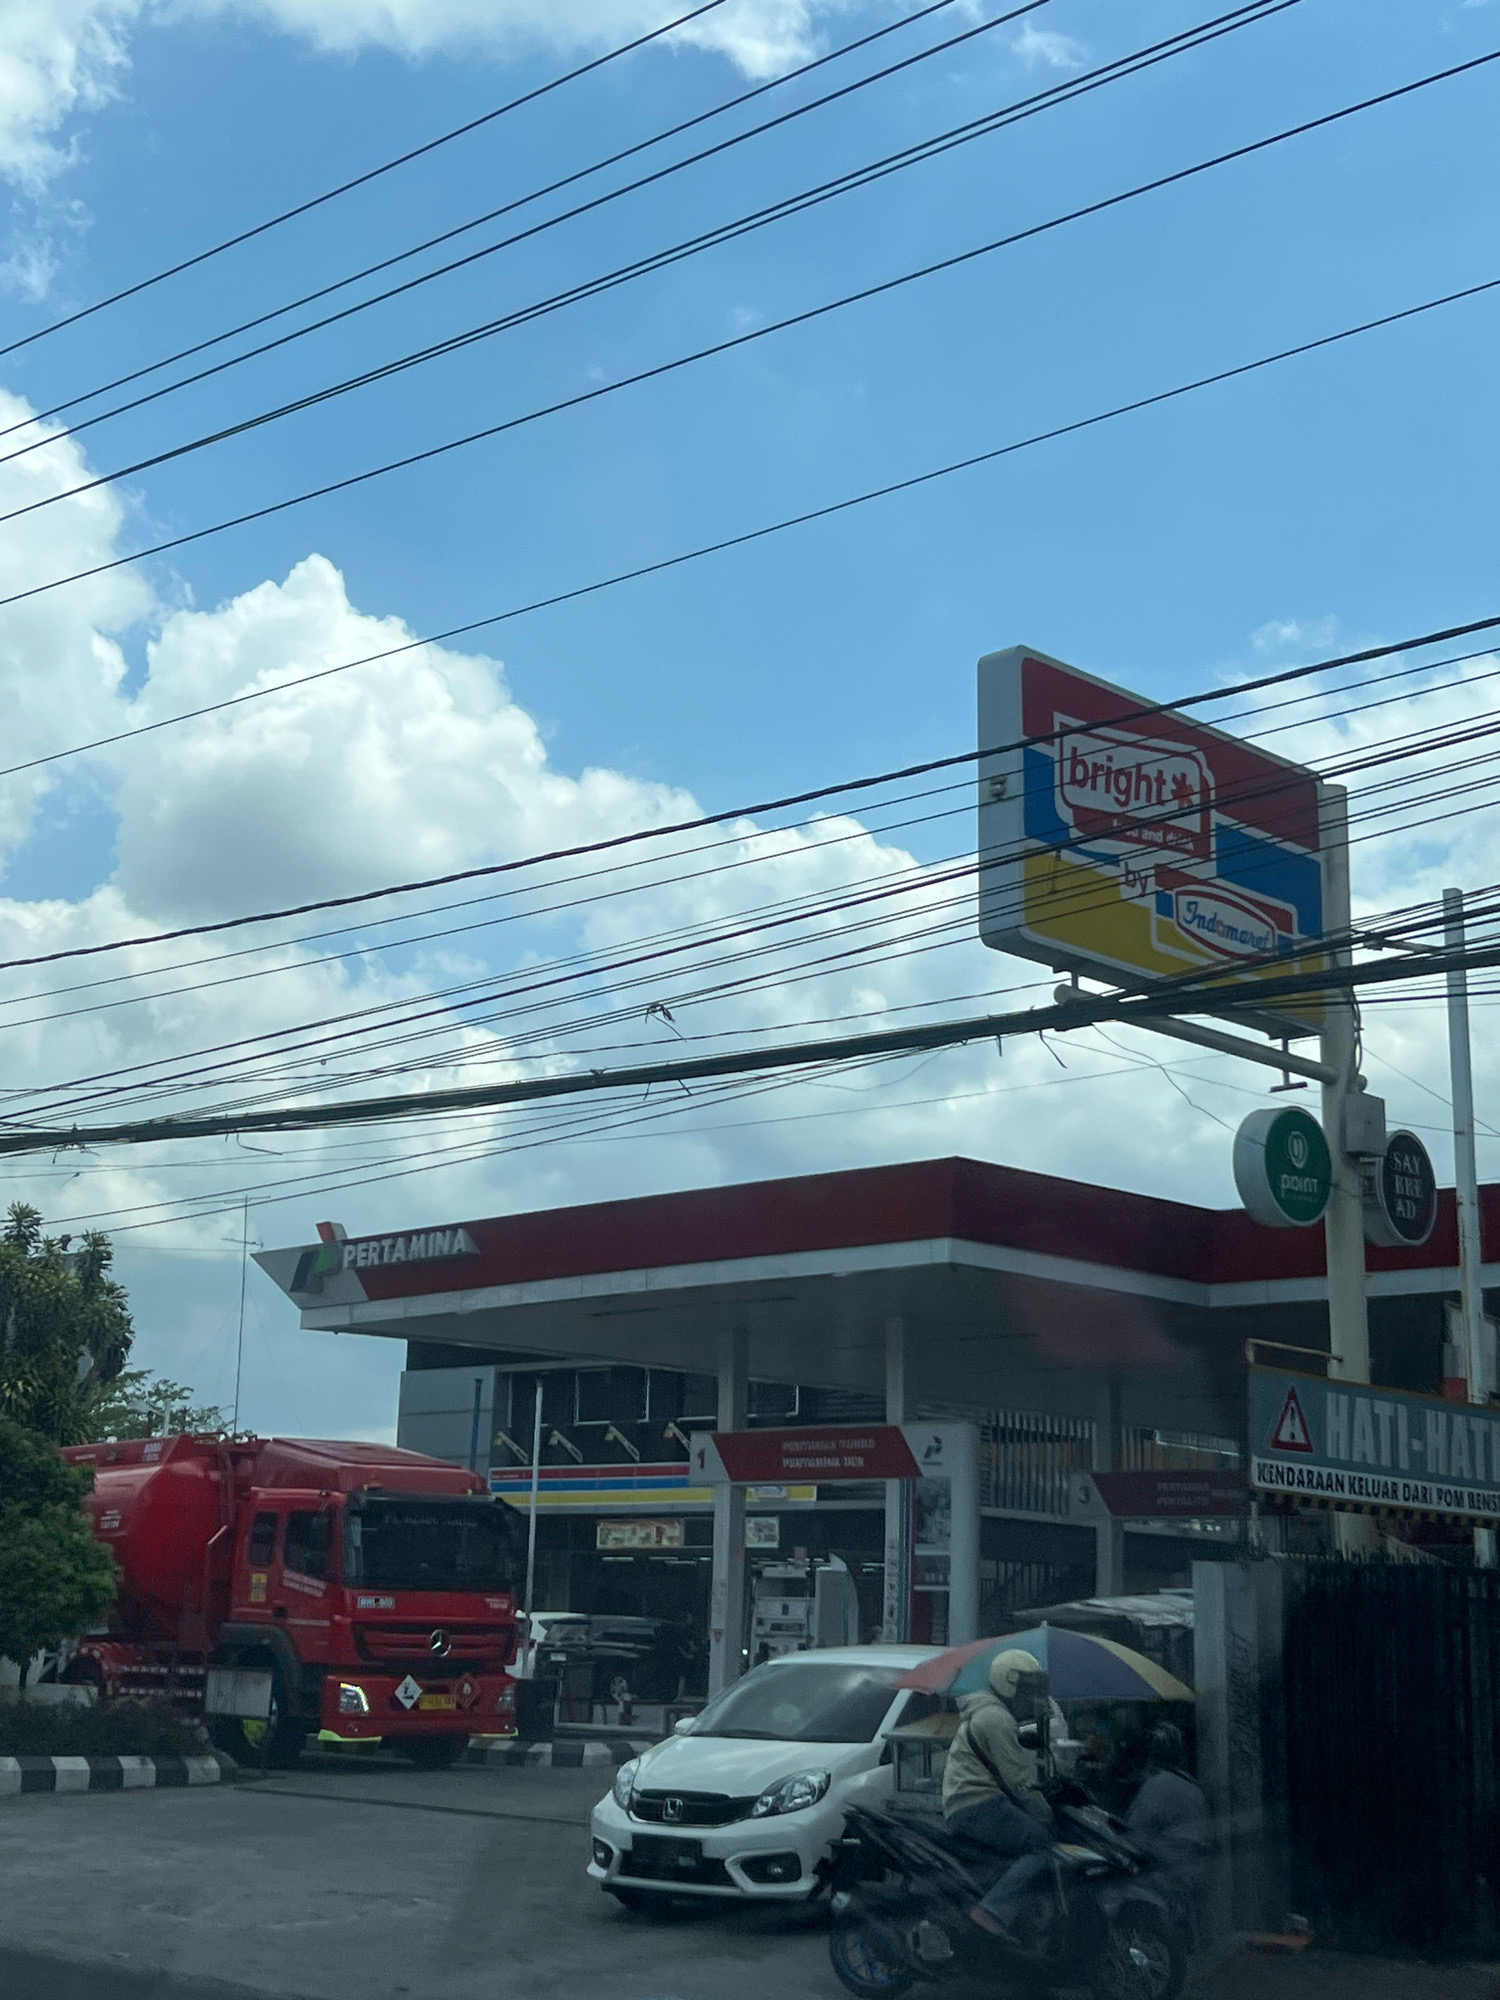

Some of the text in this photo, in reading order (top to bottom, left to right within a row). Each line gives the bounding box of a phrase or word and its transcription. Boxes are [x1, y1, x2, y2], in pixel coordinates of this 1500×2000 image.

[1070, 746, 1167, 807] bright
[1141, 829, 1163, 843] and
[1125, 861, 1148, 897] by
[1182, 900, 1271, 950] Indomaret
[1390, 1152, 1421, 1176] SAY
[1396, 1198, 1417, 1220] AD
[343, 1227, 474, 1269] PERTAMINA
[1325, 1391, 1500, 1484] HATI-HATI
[1257, 1461, 1345, 1494] KENDARAAN
[1347, 1475, 1398, 1501] KELUAR
[1402, 1483, 1433, 1505] DARI
[1436, 1487, 1465, 1508] POM
